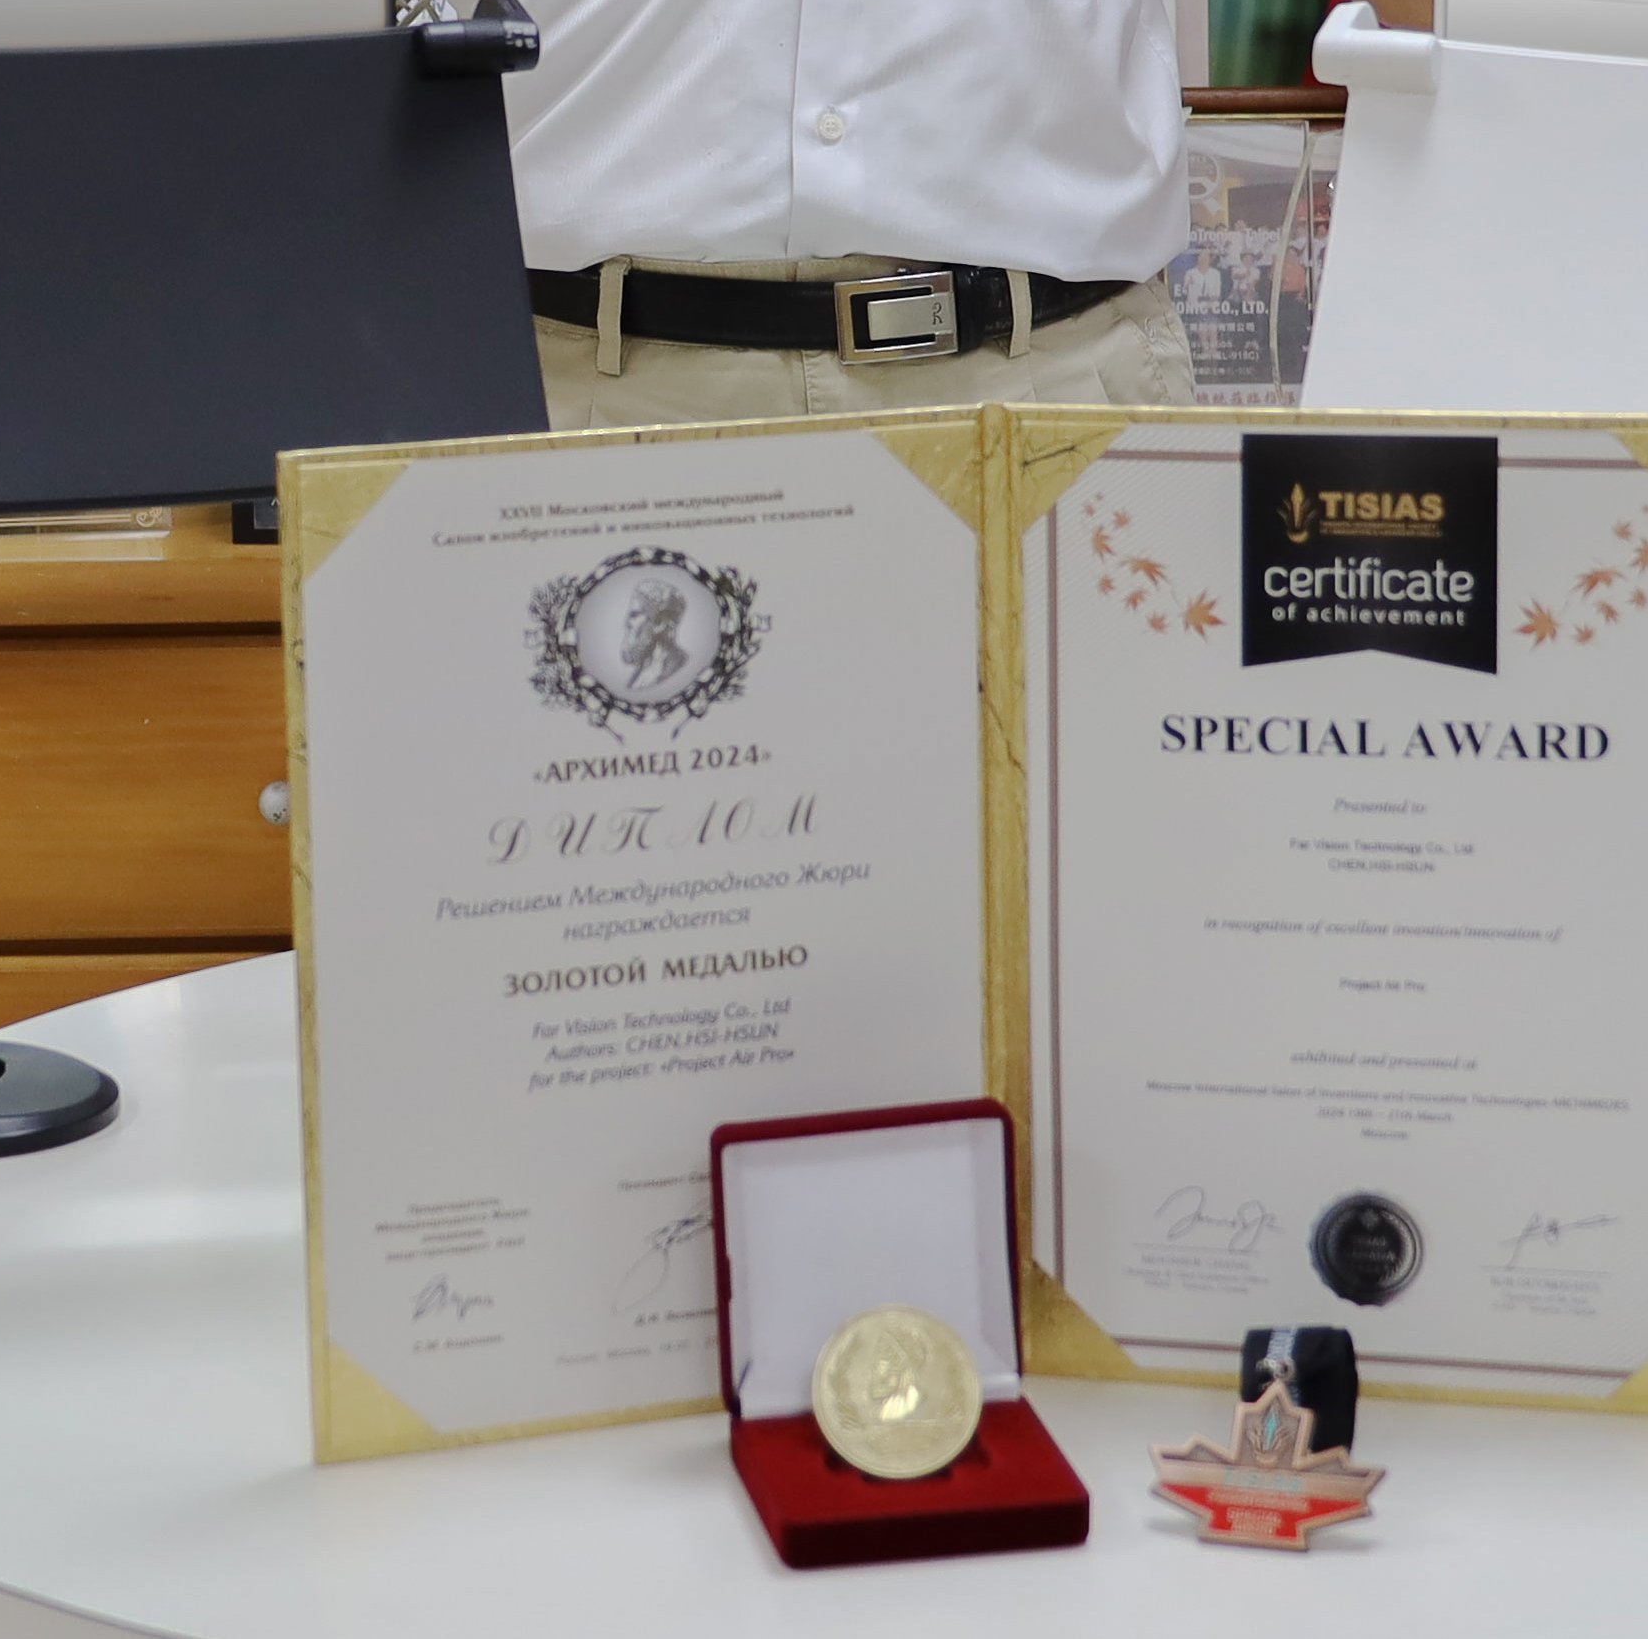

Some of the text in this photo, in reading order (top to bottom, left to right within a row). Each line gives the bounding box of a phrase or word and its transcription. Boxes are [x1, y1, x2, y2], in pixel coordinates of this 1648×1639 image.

[1318, 491, 1445, 522] TISIAS
[1264, 556, 1475, 602] certificate
[1271, 602, 1467, 627] of achievement
[1160, 713, 1610, 761] SPECIAL AWARD
[533, 743, 772, 784] «АРХИМЕД 2024»
[435, 861, 871, 921] Решением Международного Жюри
[563, 905, 751, 942] награждается
[502, 943, 810, 999] ЗОЛОТОЙ МЕДАЛЬЮ
